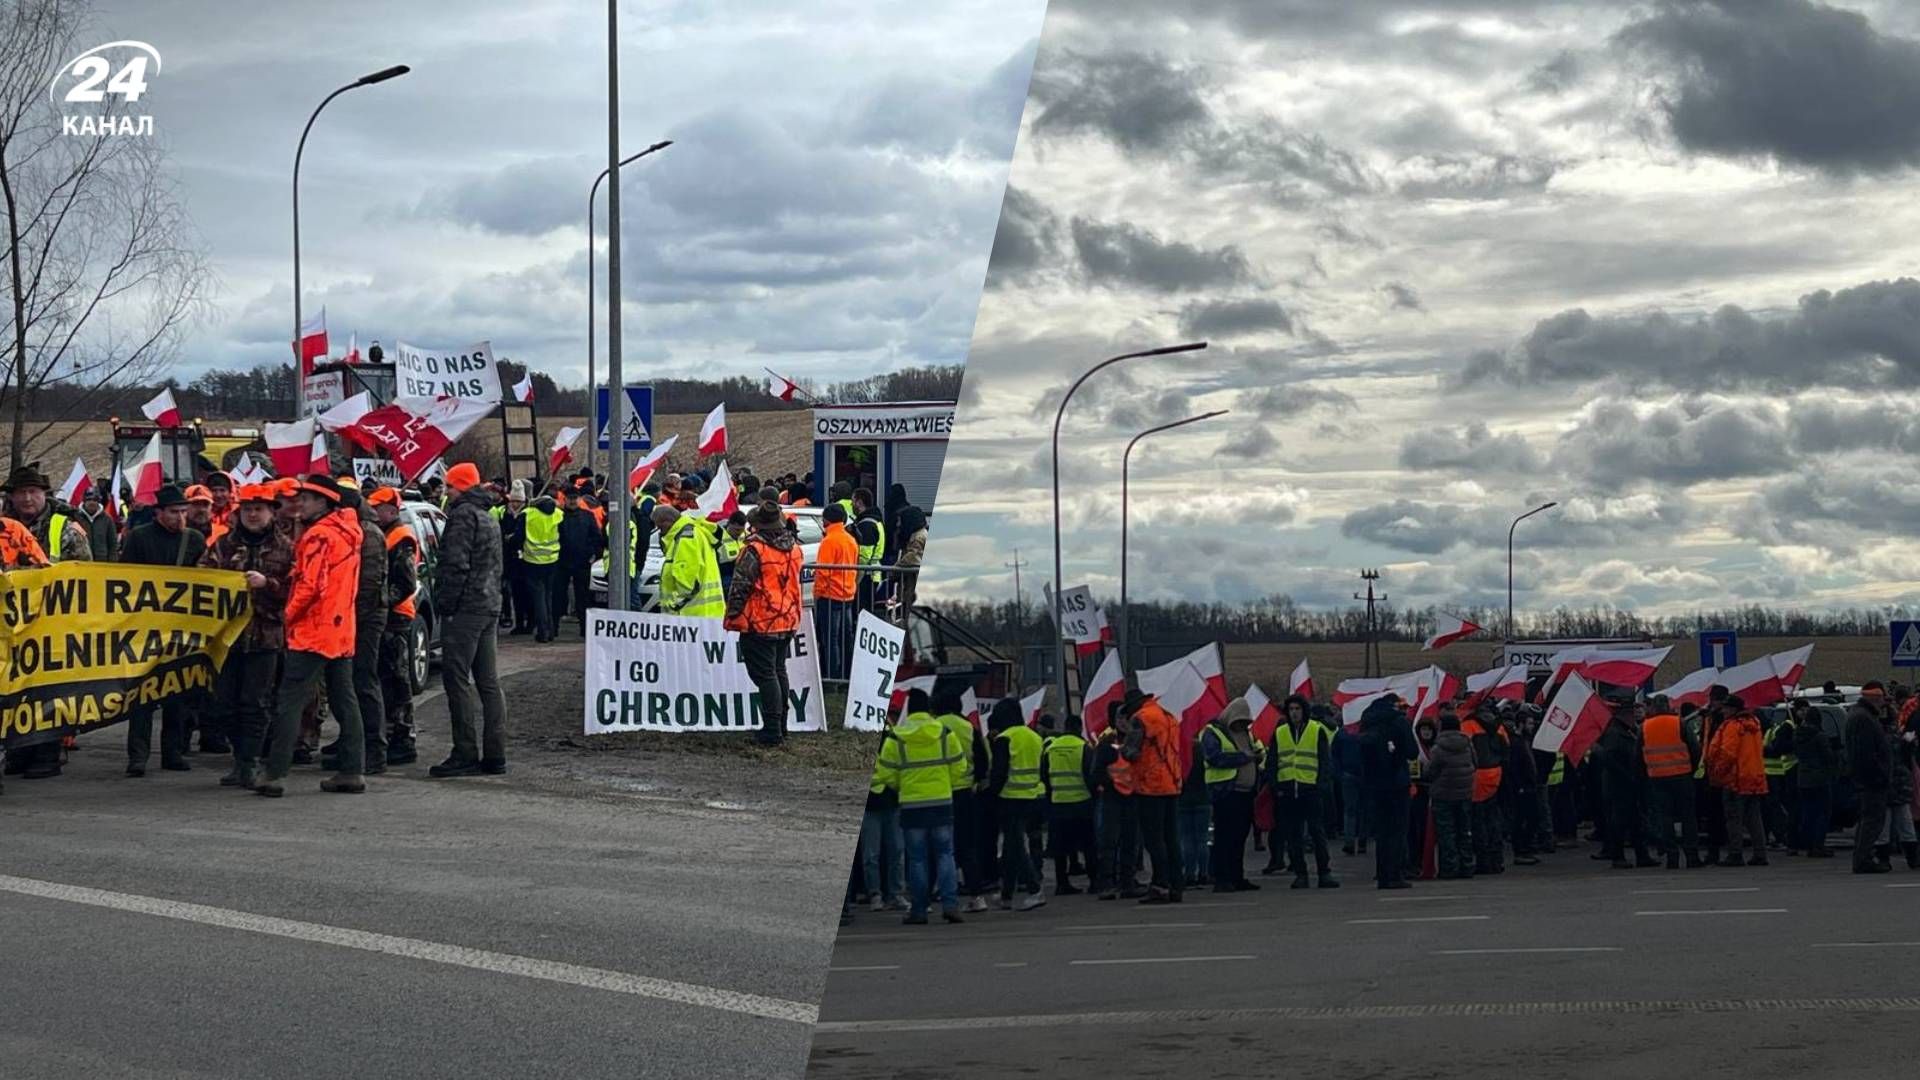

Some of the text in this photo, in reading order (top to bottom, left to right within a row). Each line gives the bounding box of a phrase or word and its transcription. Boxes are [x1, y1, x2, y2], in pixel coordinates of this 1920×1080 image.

[426, 357, 439, 374] O
[444, 351, 486, 374] NAS
[442, 378, 483, 398] NAS
[817, 417, 909, 434] OSZUKANA
[105, 579, 249, 622] RAZEM
[594, 618, 699, 643] PRACUJEMY
[702, 641, 726, 664] W
[614, 659, 660, 684] I GO
